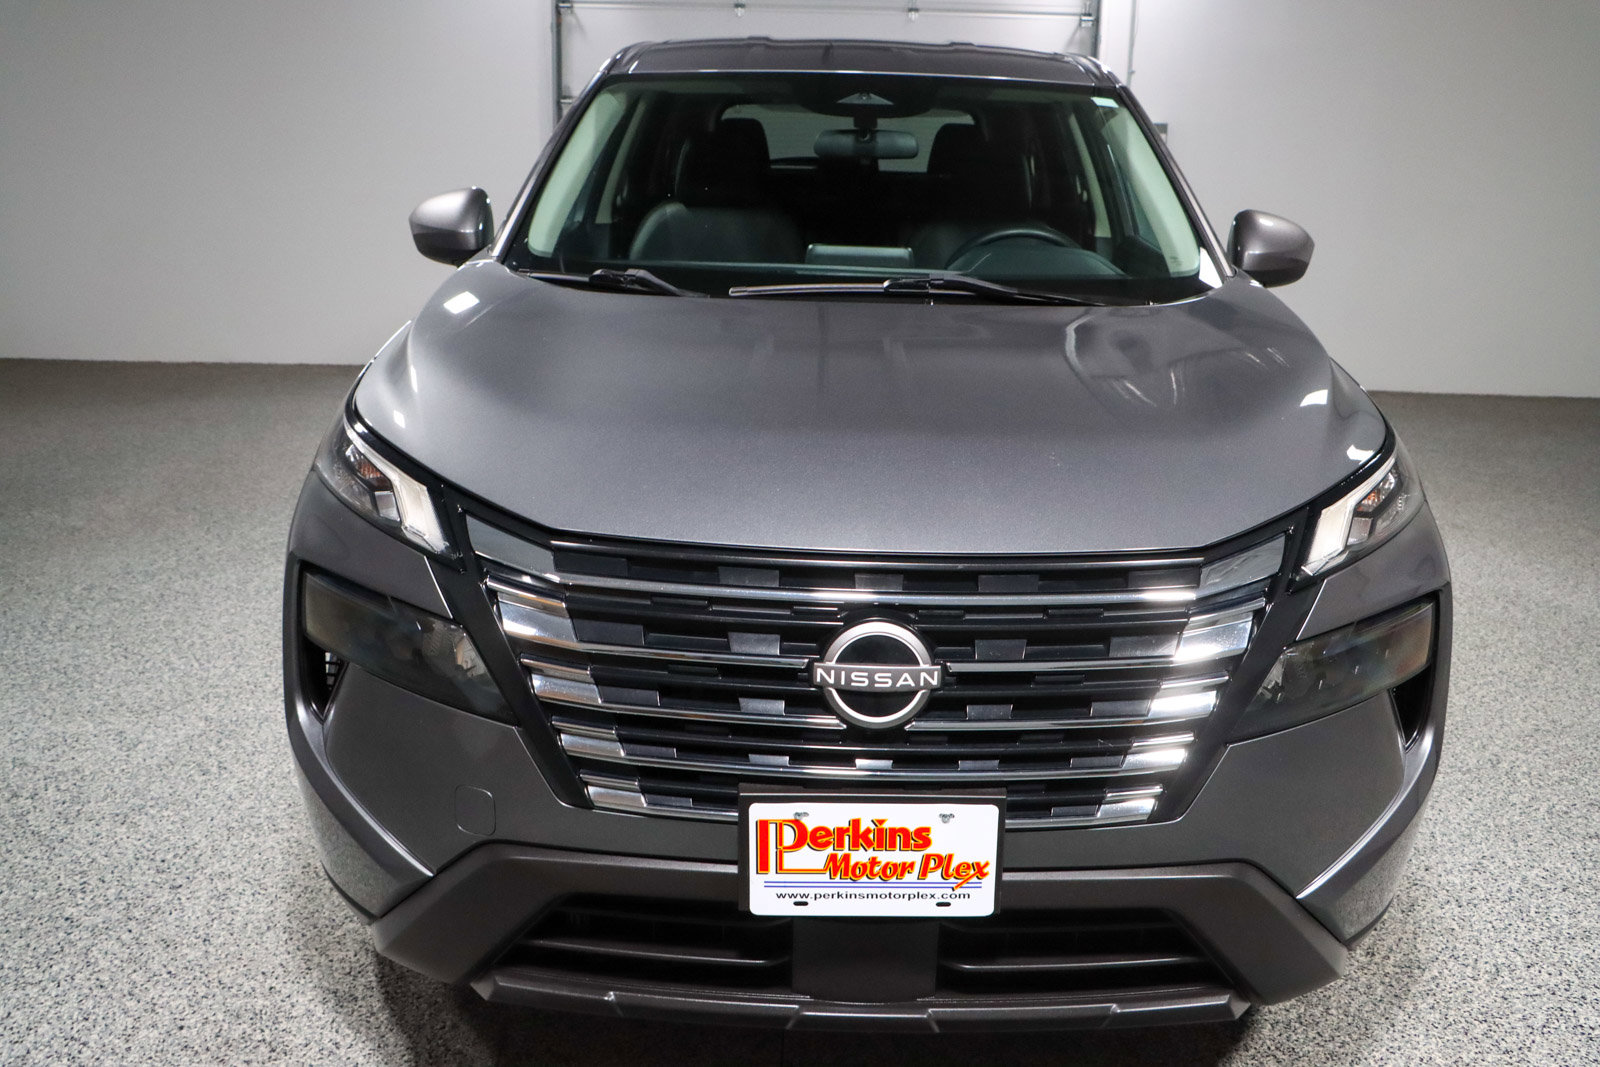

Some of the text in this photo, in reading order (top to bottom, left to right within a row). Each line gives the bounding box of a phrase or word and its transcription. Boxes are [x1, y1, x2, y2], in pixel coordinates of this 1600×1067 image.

[816, 668, 938, 687] NISSAN
[756, 818, 932, 874] Perkins
[823, 853, 990, 891] Motor Plex
[776, 891, 971, 901] www.perkinsmotorplex.com
